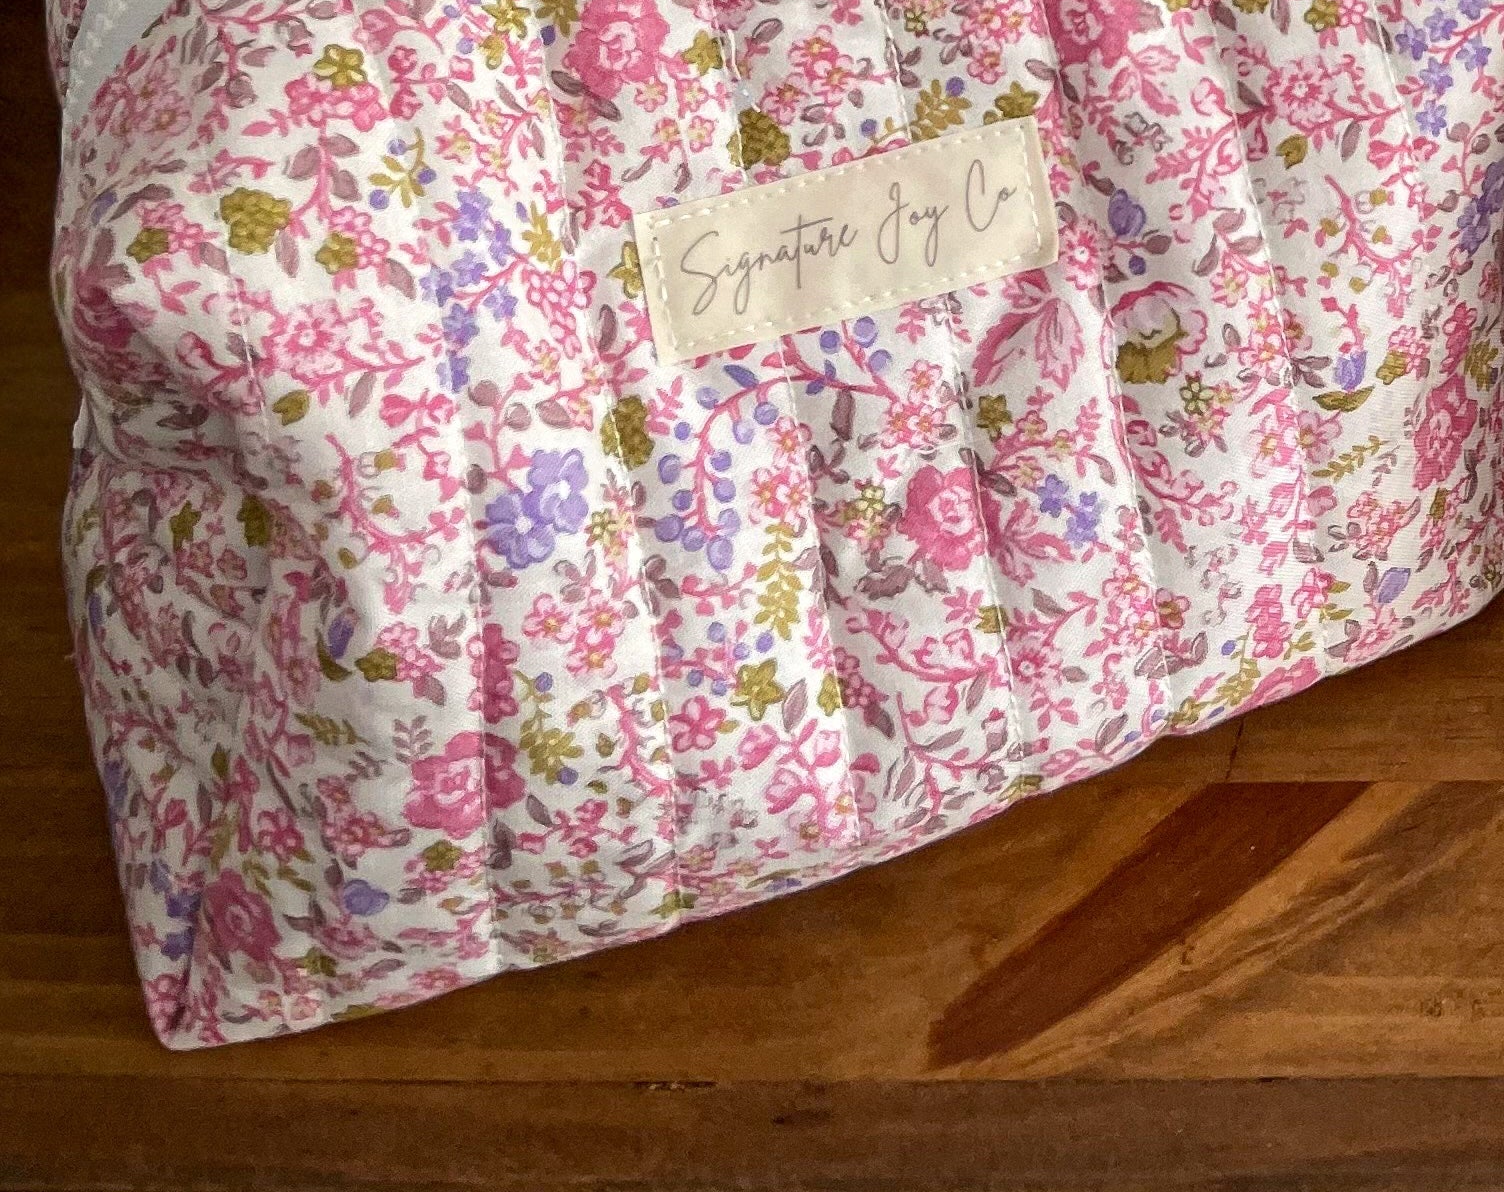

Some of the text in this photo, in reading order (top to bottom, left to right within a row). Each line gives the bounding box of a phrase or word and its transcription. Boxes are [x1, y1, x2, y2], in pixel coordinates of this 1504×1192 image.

[681, 159, 1017, 317] Signature Joy Co
